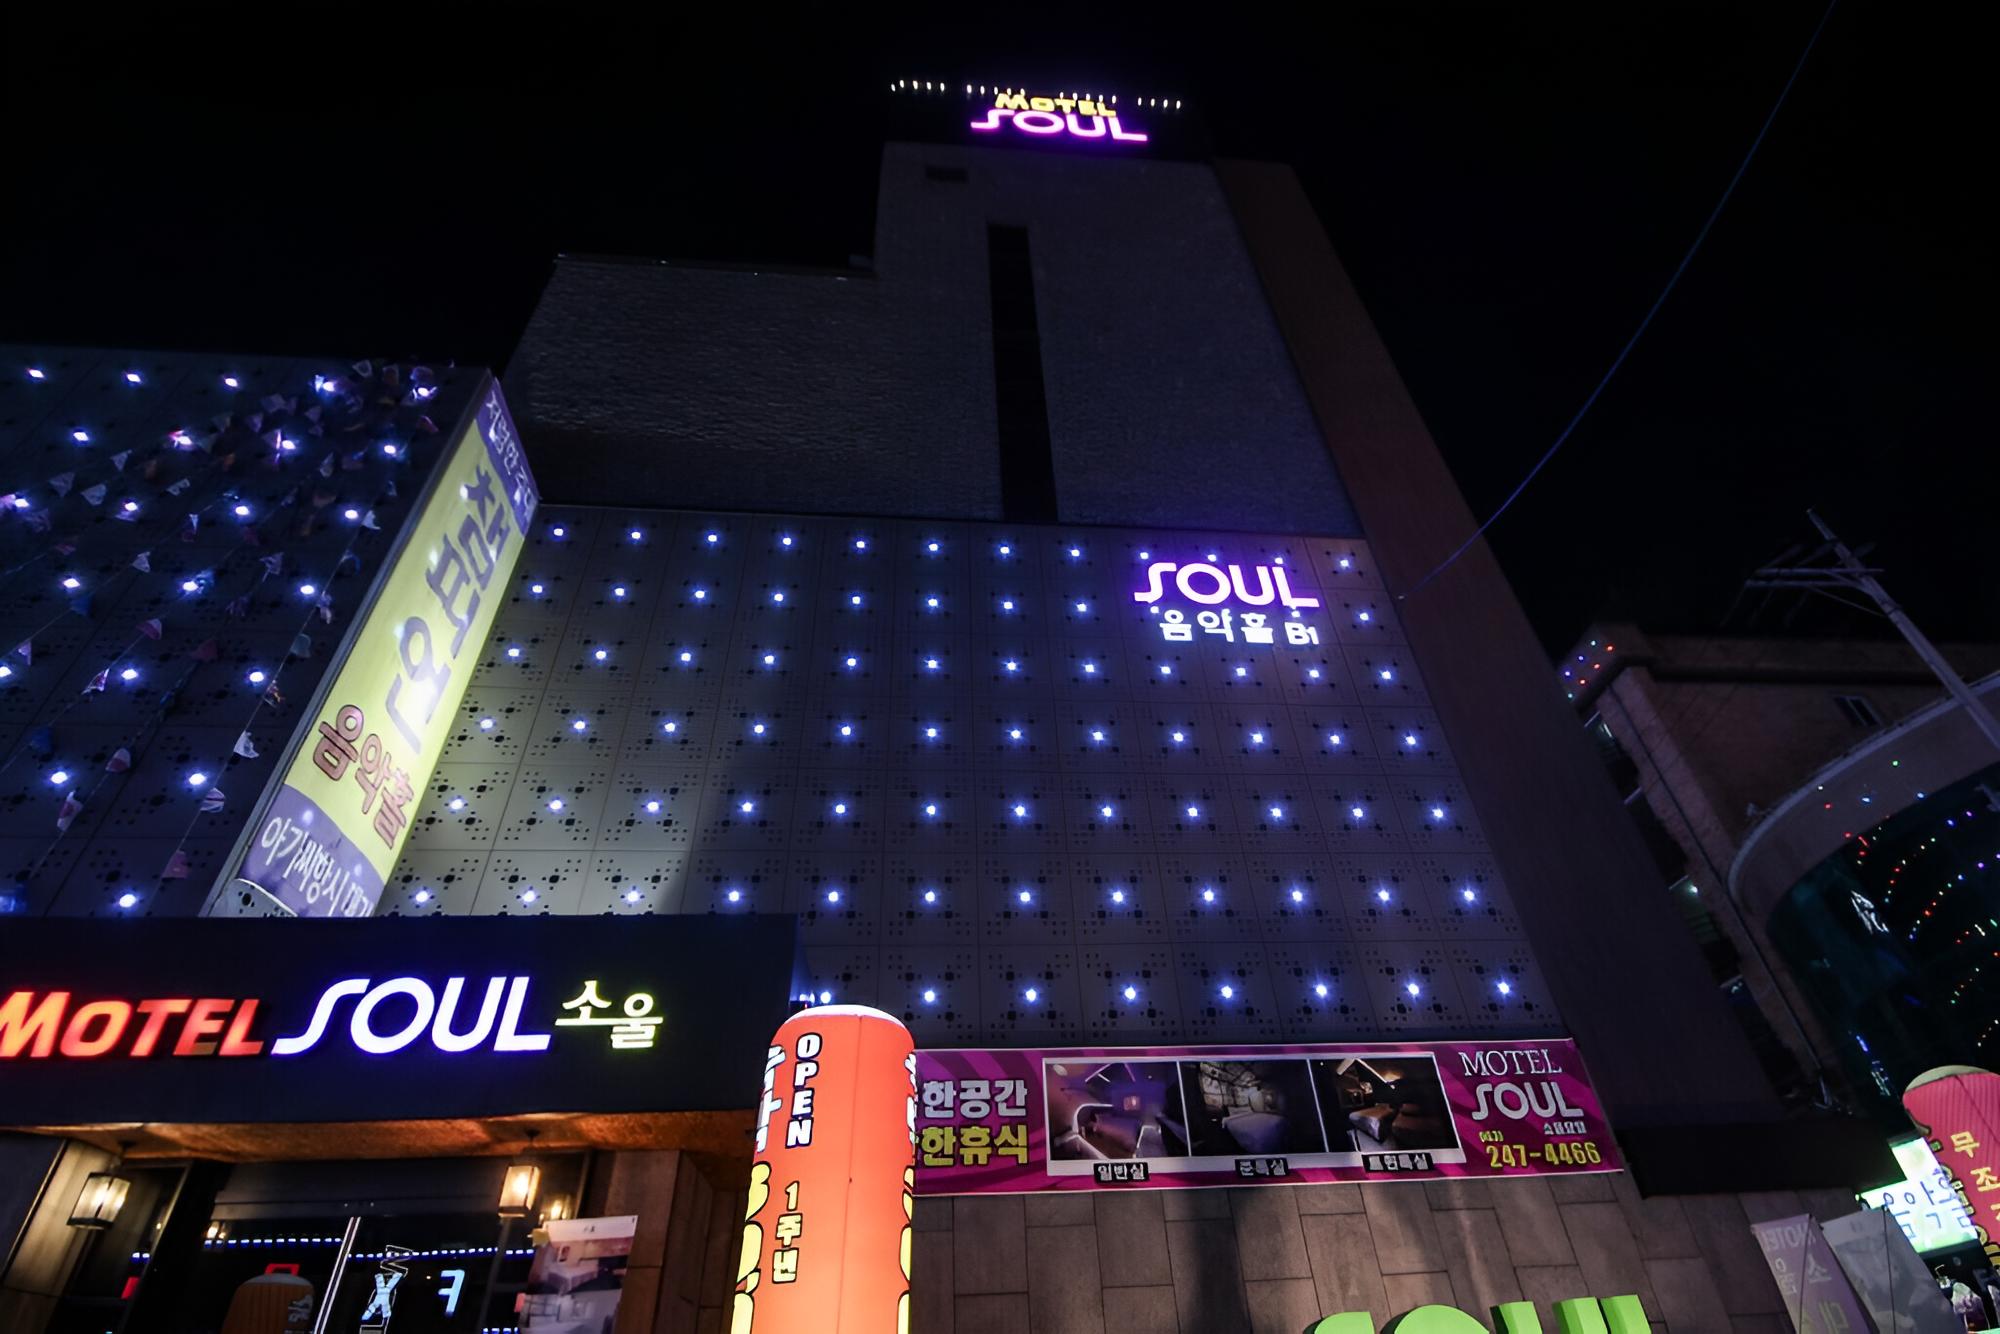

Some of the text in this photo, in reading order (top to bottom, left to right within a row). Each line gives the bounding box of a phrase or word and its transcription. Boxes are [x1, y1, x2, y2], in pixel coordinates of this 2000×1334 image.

[970, 109, 1148, 142] SOUL
[995, 93, 1116, 117] MOTEL
[1134, 562, 1320, 607] SOUL
[385, 464, 510, 755] 챔피언
[1159, 609, 1319, 644] 음악홀 B1
[311, 703, 415, 850] 음악홀
[0, 976, 663, 1058] MOTEL SOUL 소울
[1458, 1049, 1563, 1077] MOTEL
[785, 1033, 822, 1148] OPEN
[1471, 1081, 1585, 1121] SOUL
[1486, 1142, 1601, 1168] 247-4466
[772, 1181, 803, 1283] 1주년
